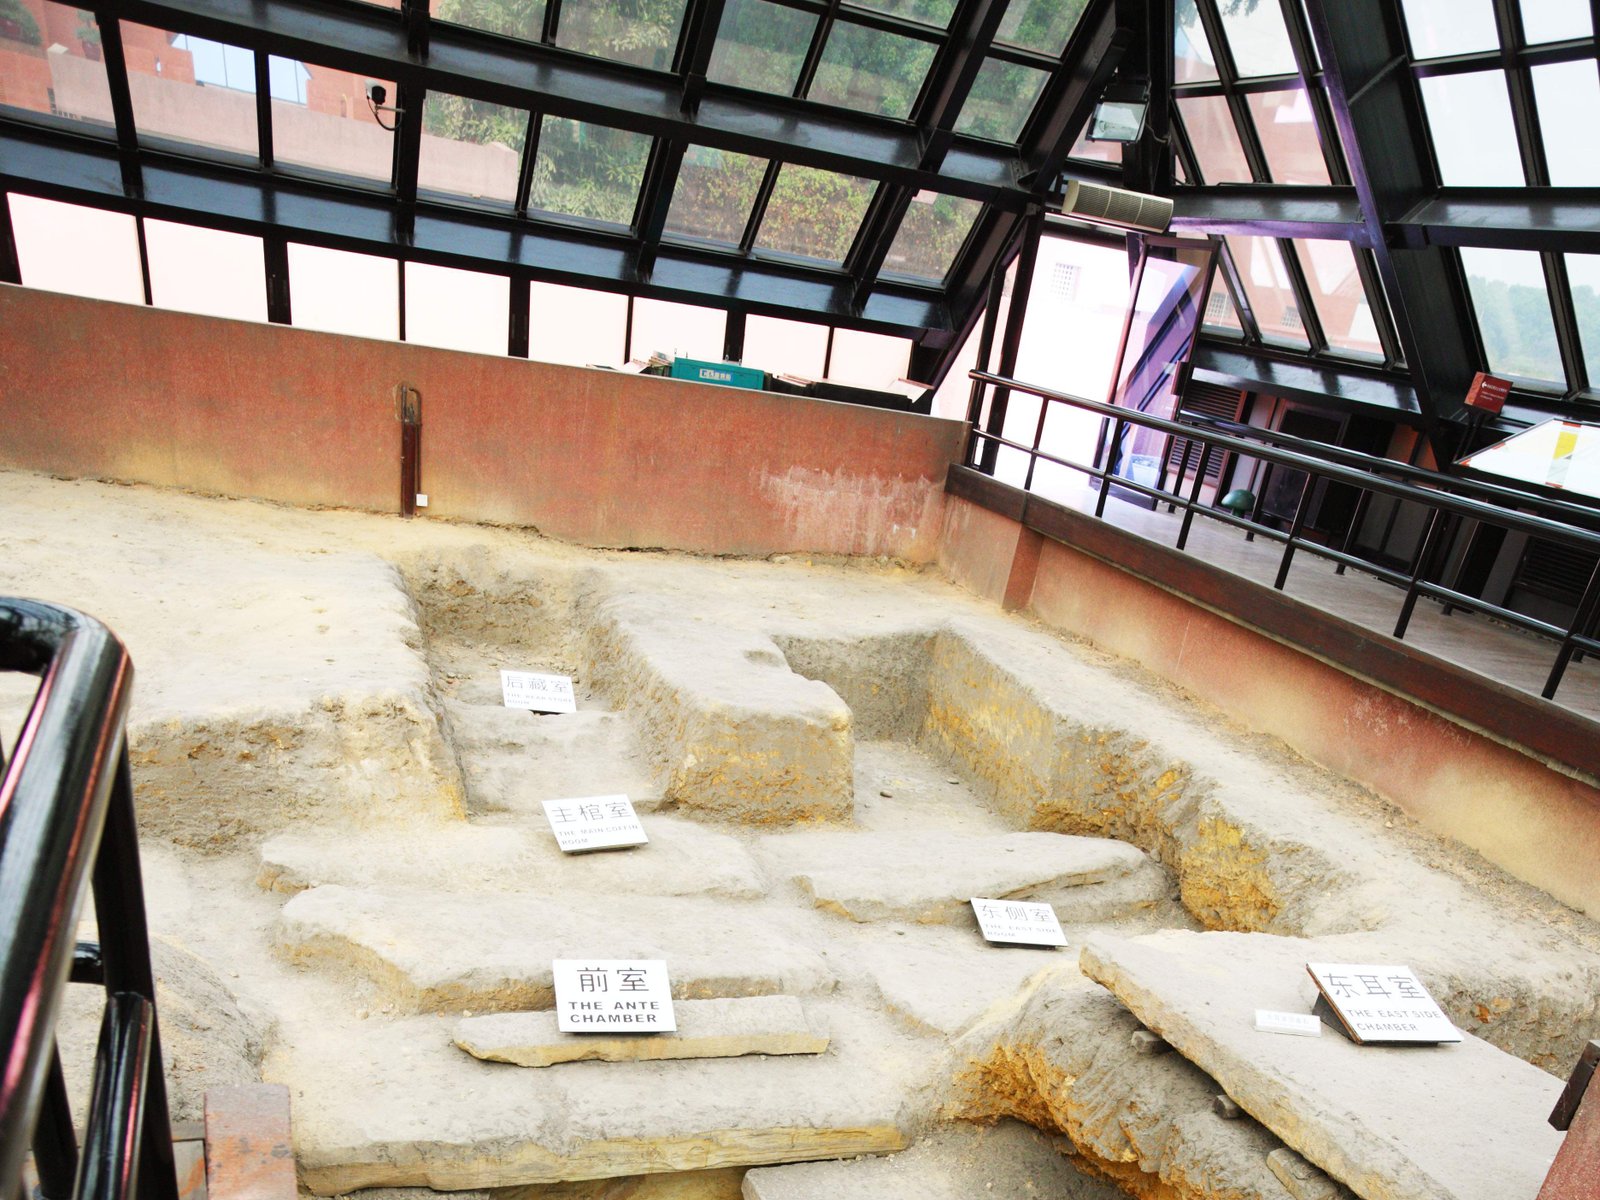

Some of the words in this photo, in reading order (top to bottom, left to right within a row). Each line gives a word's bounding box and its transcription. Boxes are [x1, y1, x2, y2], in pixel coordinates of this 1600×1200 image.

[506, 674, 570, 694] 后藏室
[551, 801, 631, 823] 主棺室
[560, 838, 588, 846] ROOM
[577, 967, 649, 992] 前室
[1322, 972, 1426, 999] 东耳室
[568, 1001, 603, 1010] THE
[613, 1001, 660, 1010] ANTE
[570, 1013, 657, 1023] CHAMBER
[1345, 1008, 1374, 1018] THE
[1378, 1009, 1410, 1019] EAST
[1413, 1010, 1441, 1020] SIDE
[1356, 1022, 1419, 1032] CHAMBER
